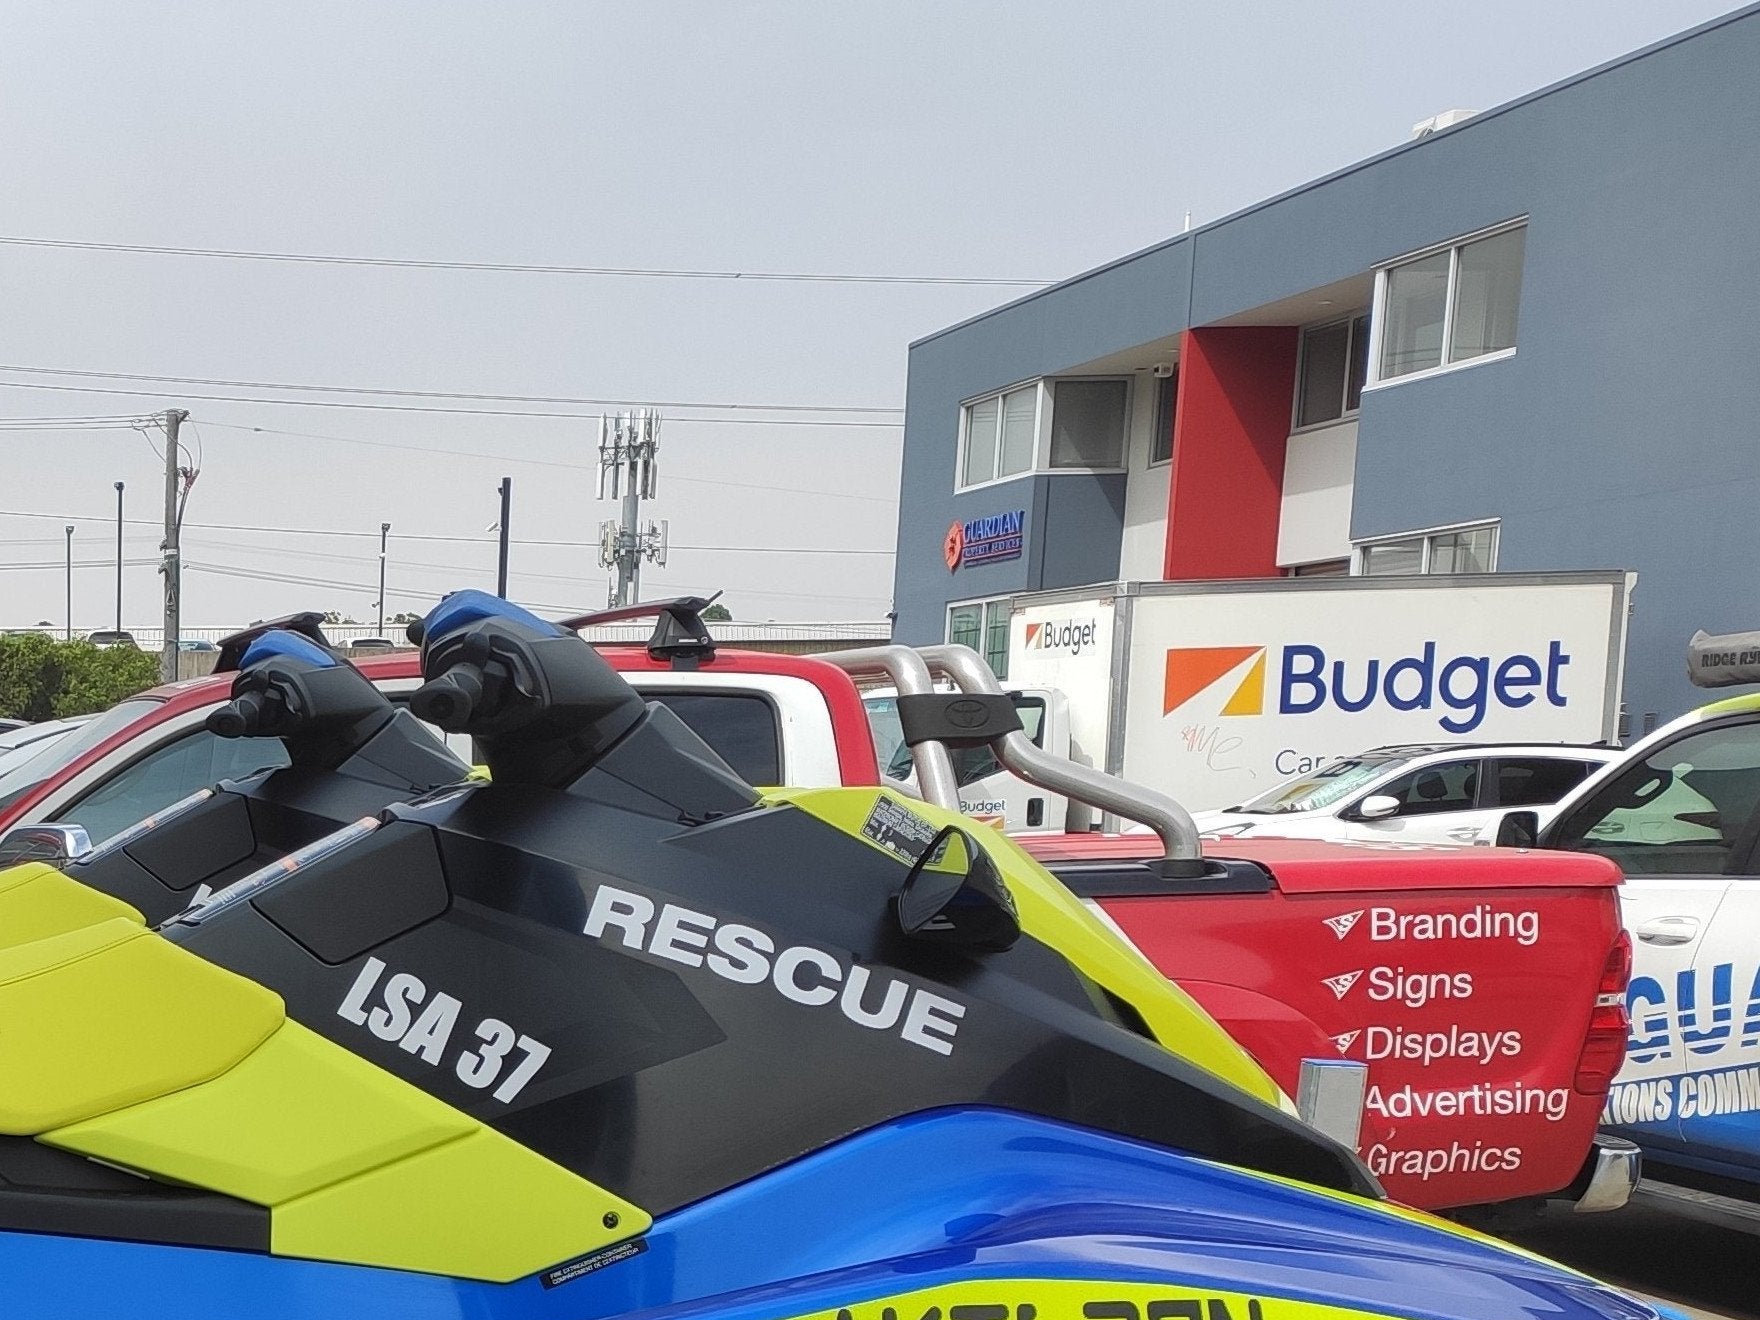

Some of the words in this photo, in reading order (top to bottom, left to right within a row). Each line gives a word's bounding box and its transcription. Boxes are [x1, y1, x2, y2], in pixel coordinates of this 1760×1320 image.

[1044, 618, 1096, 655] Budget
[1701, 652, 1737, 668] RIDGE
[1279, 640, 1571, 734] Budget
[1275, 749, 1323, 775] Car
[959, 800, 1006, 814] Budget
[1370, 905, 1539, 945] Branding
[582, 883, 967, 1057] RESCUE
[1367, 966, 1474, 1007] Signs
[336, 955, 463, 1067] LSA
[455, 1017, 553, 1105] 37
[1365, 1024, 1522, 1066] Displays
[1365, 1081, 1570, 1121] Advertising
[1367, 1140, 1522, 1180] Graphics
